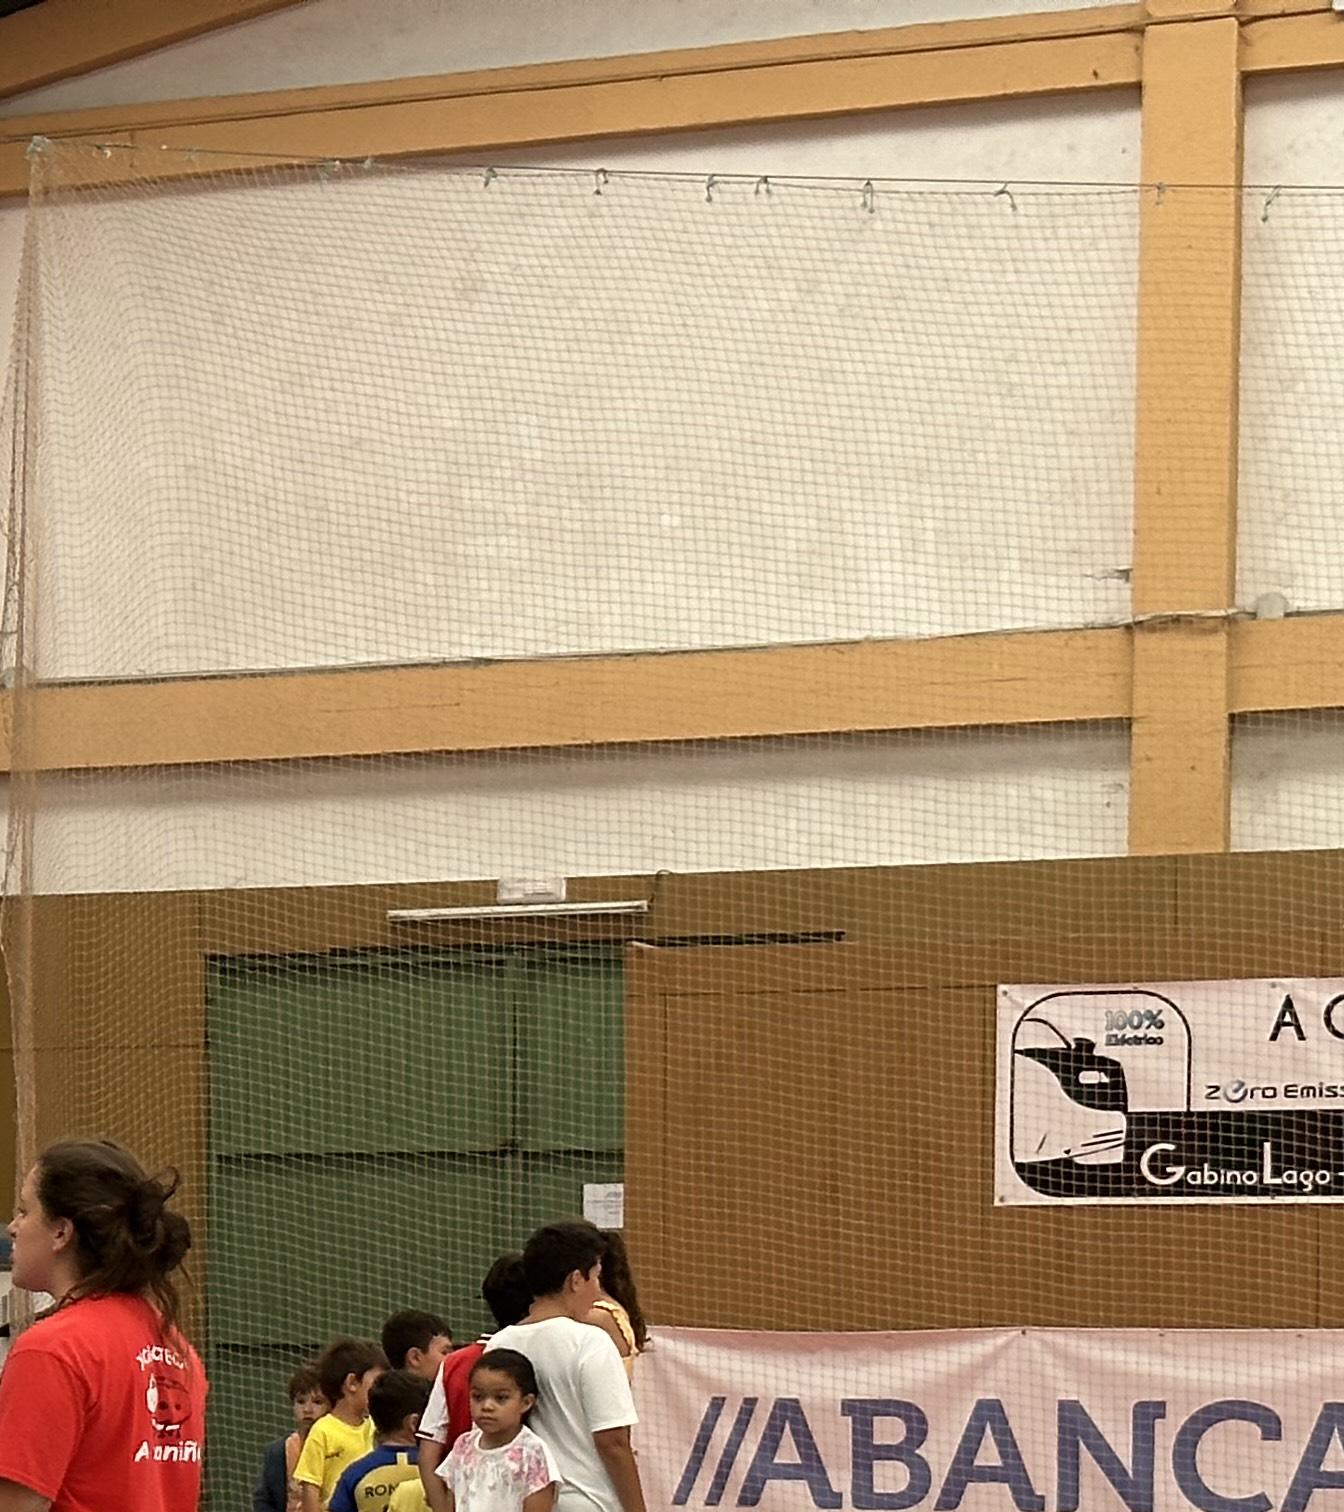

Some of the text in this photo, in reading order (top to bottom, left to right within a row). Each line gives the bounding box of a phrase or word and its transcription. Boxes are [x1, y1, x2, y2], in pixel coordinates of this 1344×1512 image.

[1105, 1009, 1165, 1031] 100%
[1268, 993, 1307, 1042] A
[1140, 1141, 1330, 1192] Gabino Lago
